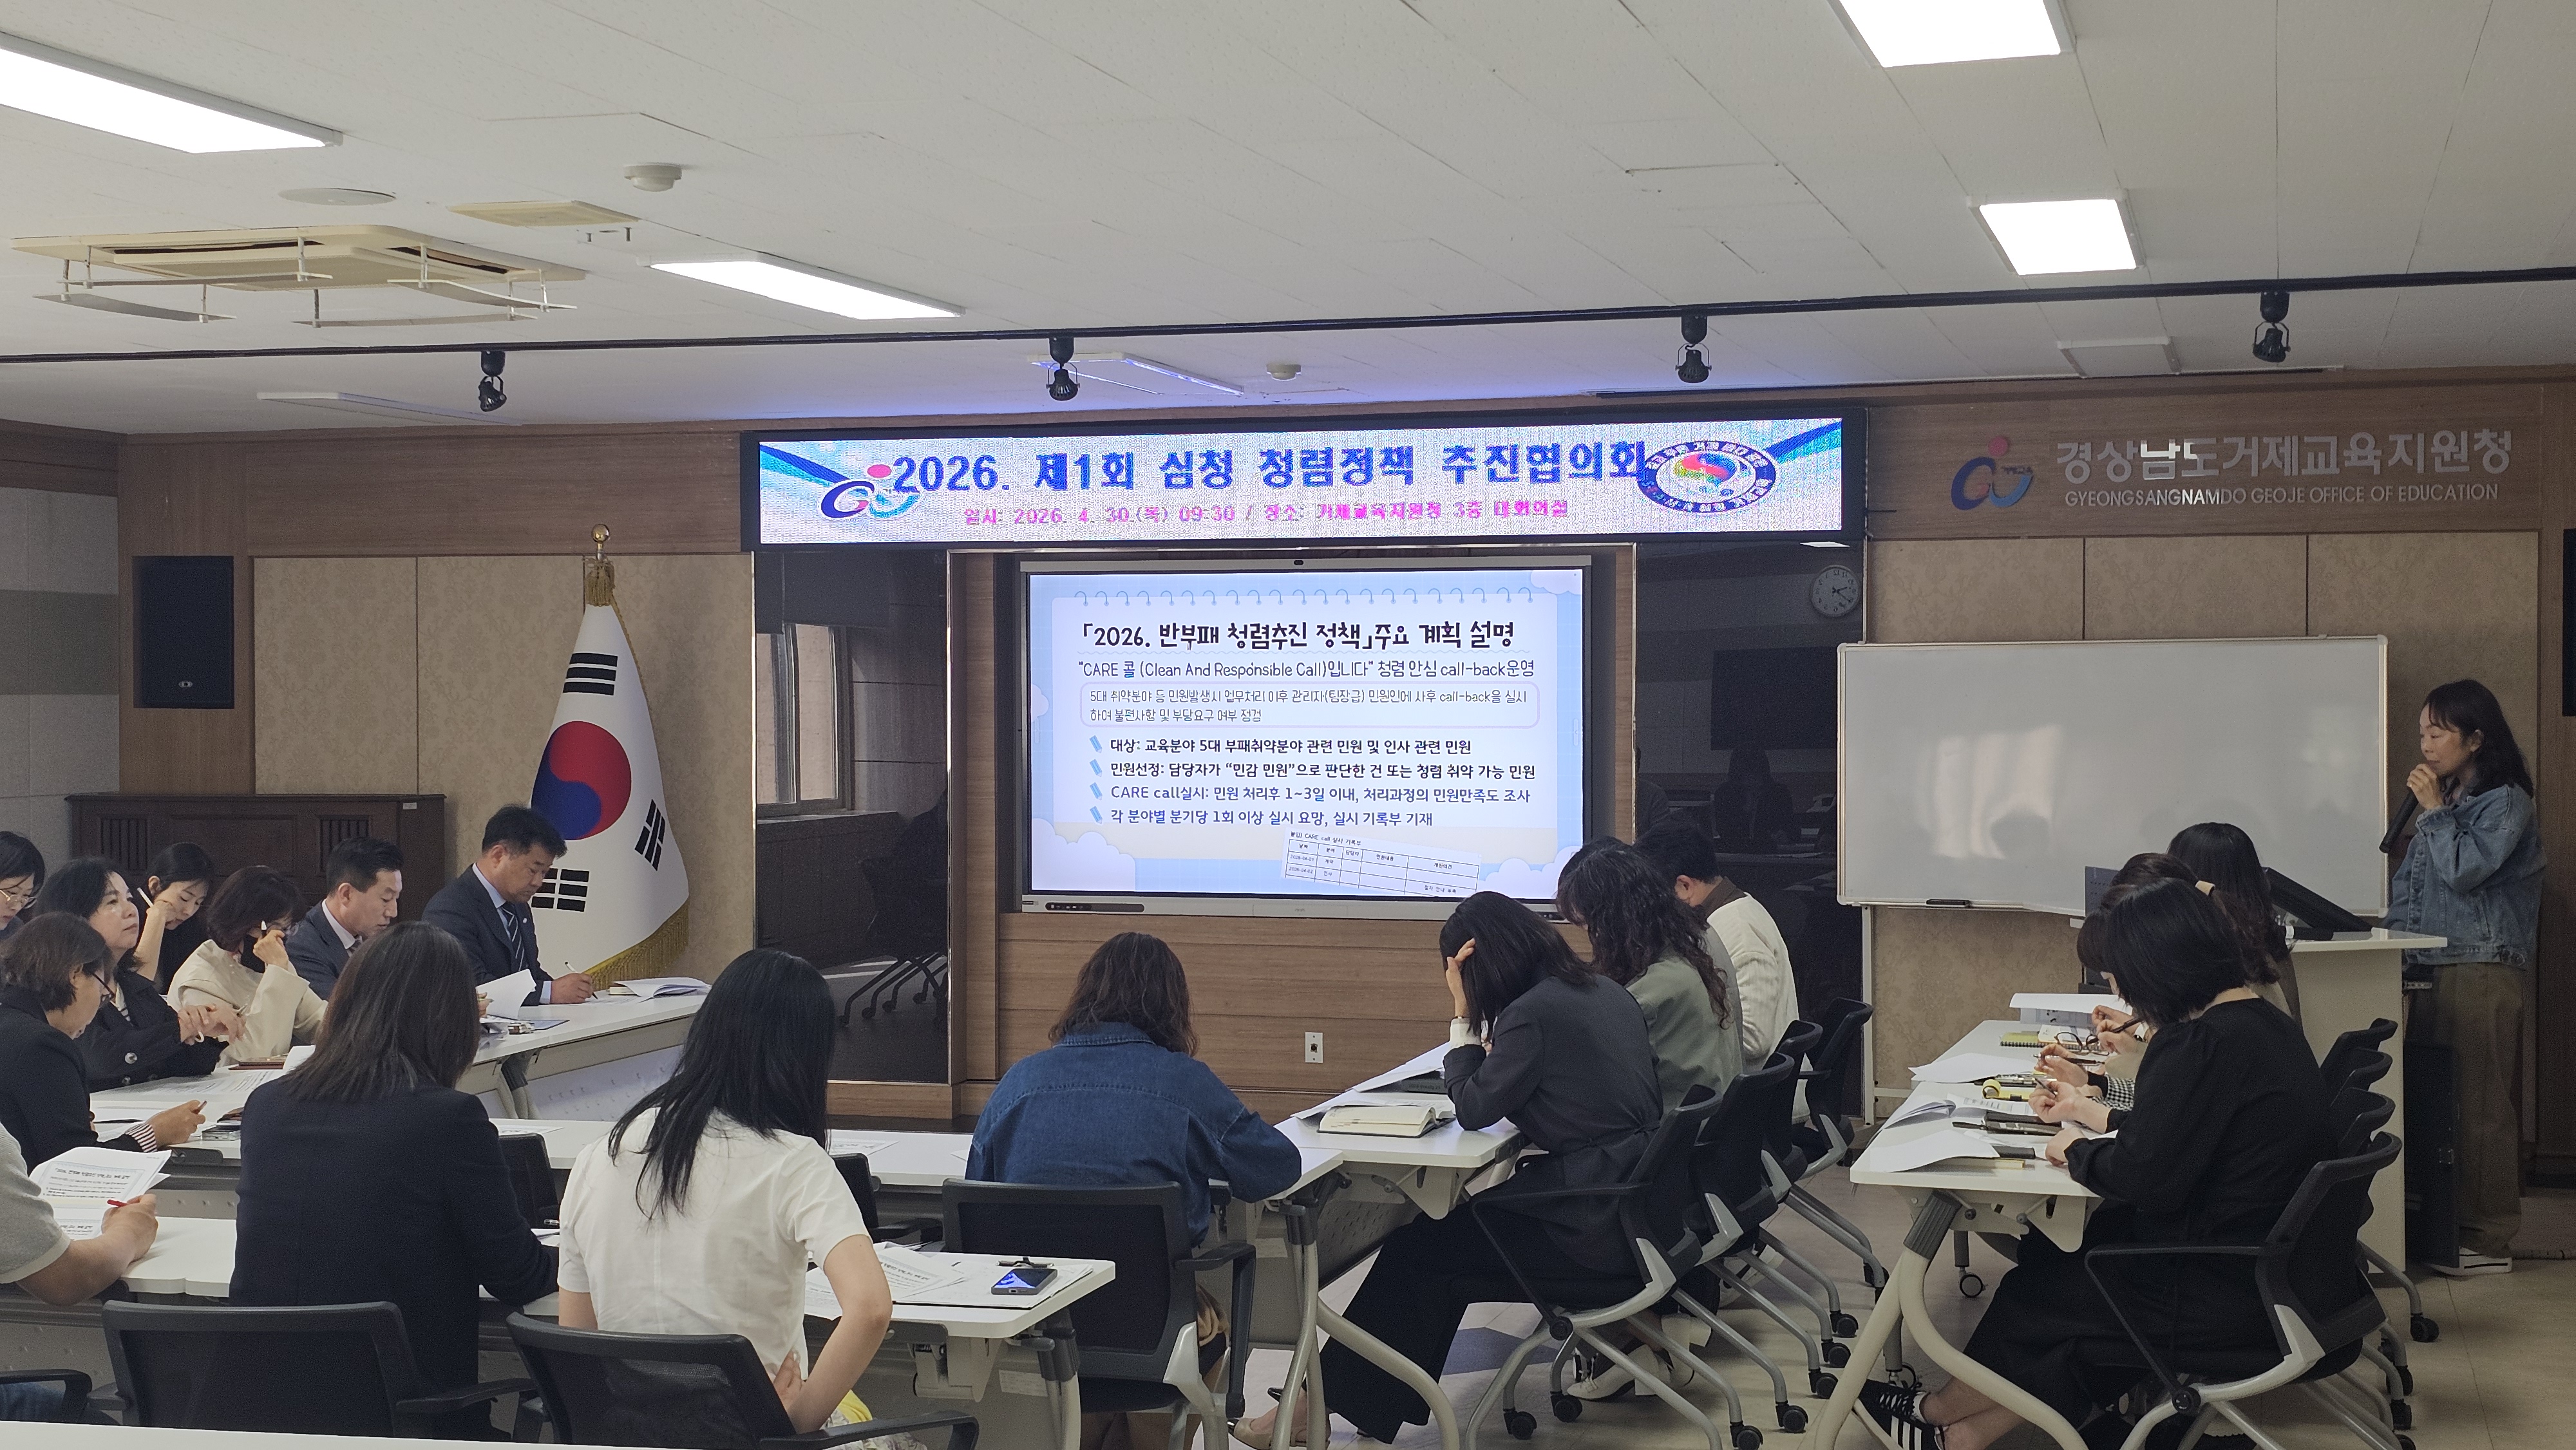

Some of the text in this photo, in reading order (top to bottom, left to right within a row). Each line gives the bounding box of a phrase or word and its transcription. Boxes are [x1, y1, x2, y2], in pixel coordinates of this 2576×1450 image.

[2057, 429, 2513, 485] 경상남도거제교육지원청
[893, 455, 1010, 493] 2026.
[1034, 450, 1134, 490] 제1회
[1259, 444, 1414, 488] 청렴정책
[1441, 441, 1645, 484] 추진협의회
[2065, 484, 2499, 507] GYEONGSANGNAMDO GEOJE OFFICE OF EDUCATION
[964, 507, 1002, 525] 일시:
[1014, 508, 1067, 523] 2026.
[1179, 505, 1235, 522] 09:30
[1159, 622, 1219, 651] 반부패
[1227, 621, 1307, 651] 청렴추진
[1418, 621, 1461, 648] 계획
[1470, 620, 1513, 648] 설명
[1122, 661, 1135, 679] 콜
[1140, 661, 1181, 678] (Clean
[1185, 662, 1211, 677] And
[1214, 661, 1293, 679] Responsible
[1377, 660, 1405, 677] 청렴
[1408, 659, 1437, 677] 안심
[1440, 659, 1534, 677] call-back운영
[1110, 690, 1153, 703] 취약분야
[1155, 689, 1166, 703] 등
[1168, 689, 1221, 703] 민원발생시
[1224, 690, 1265, 703] 업무처리
[1268, 690, 1289, 703] 이후
[1368, 689, 1412, 703] 민원인에
[1415, 689, 1437, 703] 사후
[1439, 690, 1501, 704] call-back을
[1504, 690, 1526, 704] 실시
[1090, 708, 1112, 721] 하여
[1159, 708, 1170, 722] 및
[1172, 708, 1215, 722] 부당요구
[1217, 709, 1238, 722] 여부
[1110, 739, 1472, 755] 대상: 교육분야 5대 부패취약분야 관련 민원 및 인사 관련 민원
[1110, 762, 1164, 777] 민원선정:
[1169, 762, 1222, 778] 담당자가
[1325, 763, 1366, 778] 판단한
[1370, 764, 1382, 778] 건
[1387, 764, 1412, 778] 또는
[1417, 763, 1442, 779] 청렴
[1446, 764, 1474, 780] 취약
[1478, 765, 1505, 780] 가능
[1509, 765, 1535, 780] 민원
[1111, 786, 1531, 804] CARE call실시: 민원 처리후 1~3일 이내, 처리과정의 민원만족도 조사
[1111, 809, 1432, 827] 각 분야별 분기당 1회 이상 실시 요망, 실시 기록부 기재
